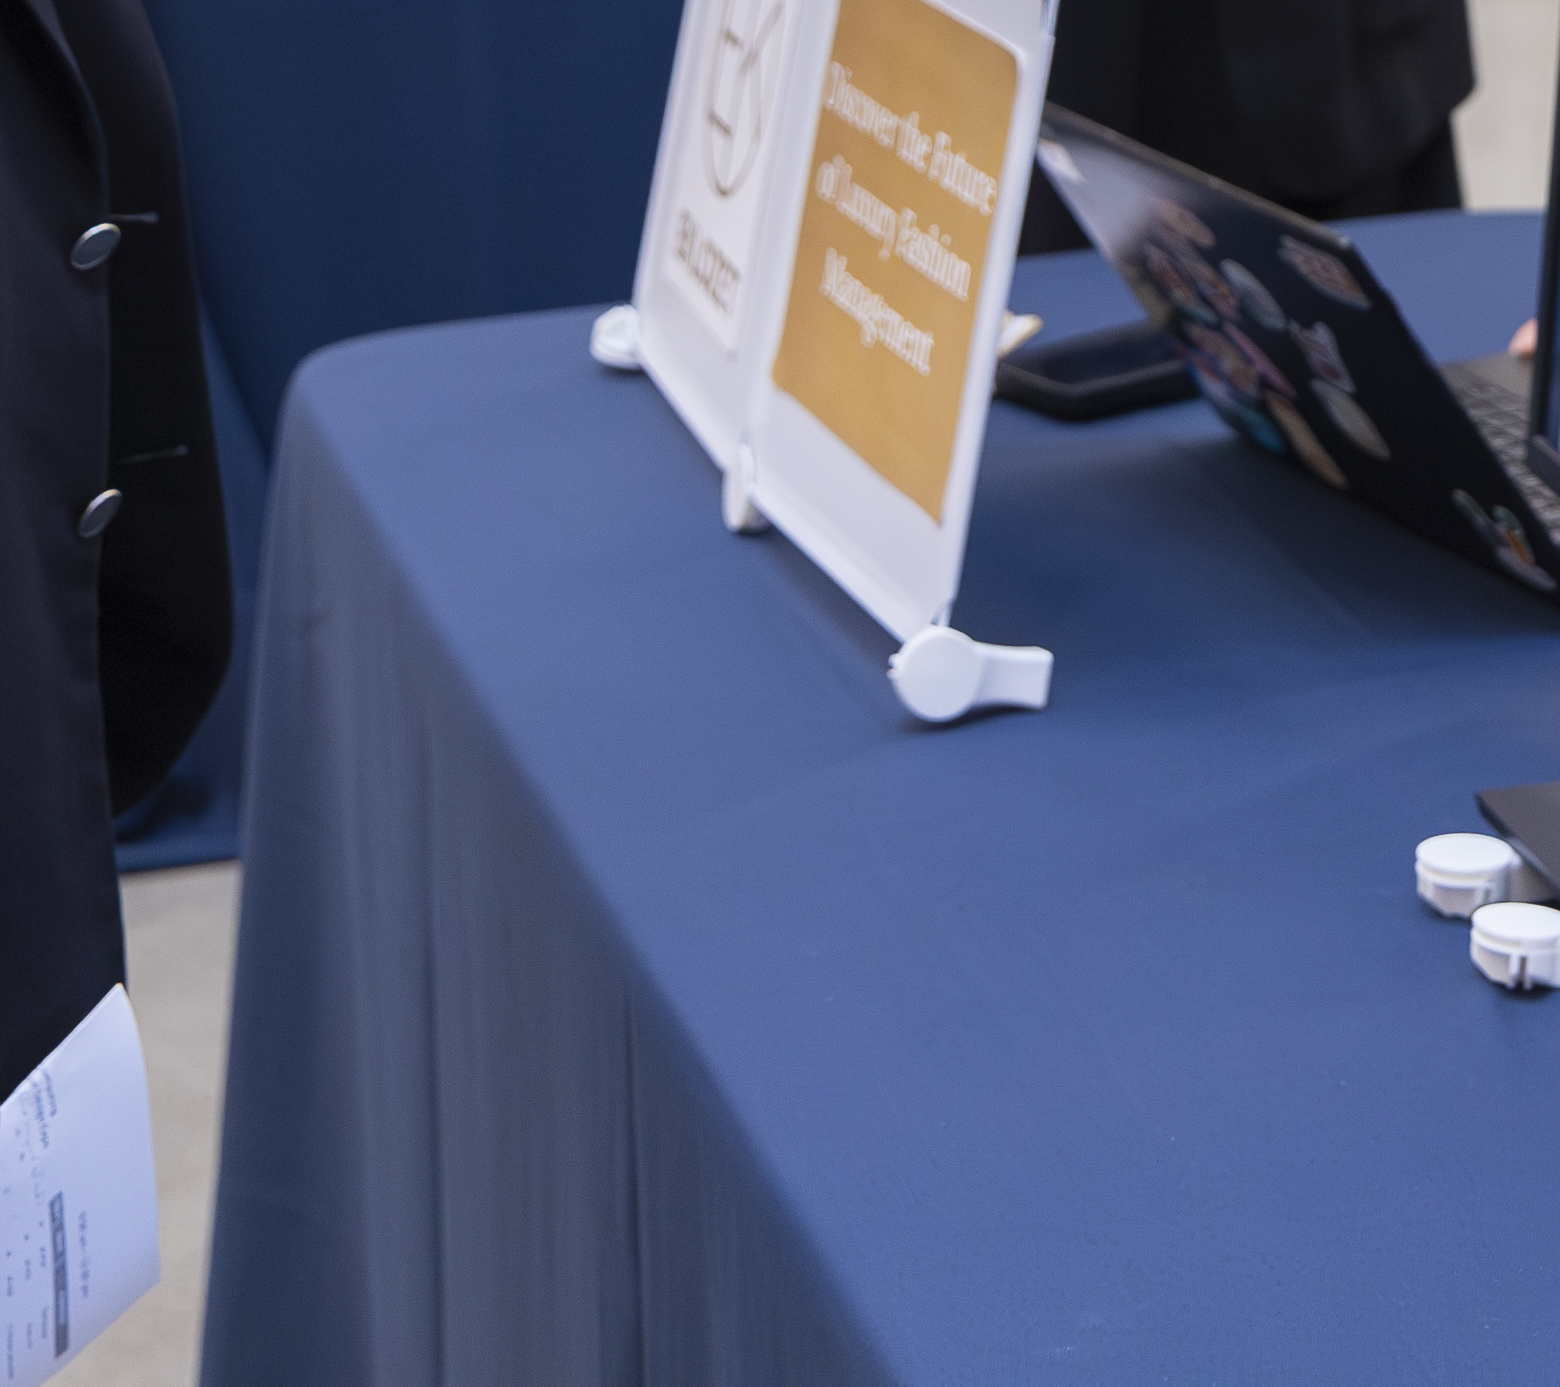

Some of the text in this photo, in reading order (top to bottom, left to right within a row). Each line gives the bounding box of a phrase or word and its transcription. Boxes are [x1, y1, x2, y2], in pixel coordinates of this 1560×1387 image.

[825, 60, 998, 217] Discover the Future
[815, 154, 972, 303] of Luxury Fashion
[819, 246, 936, 377] Management
